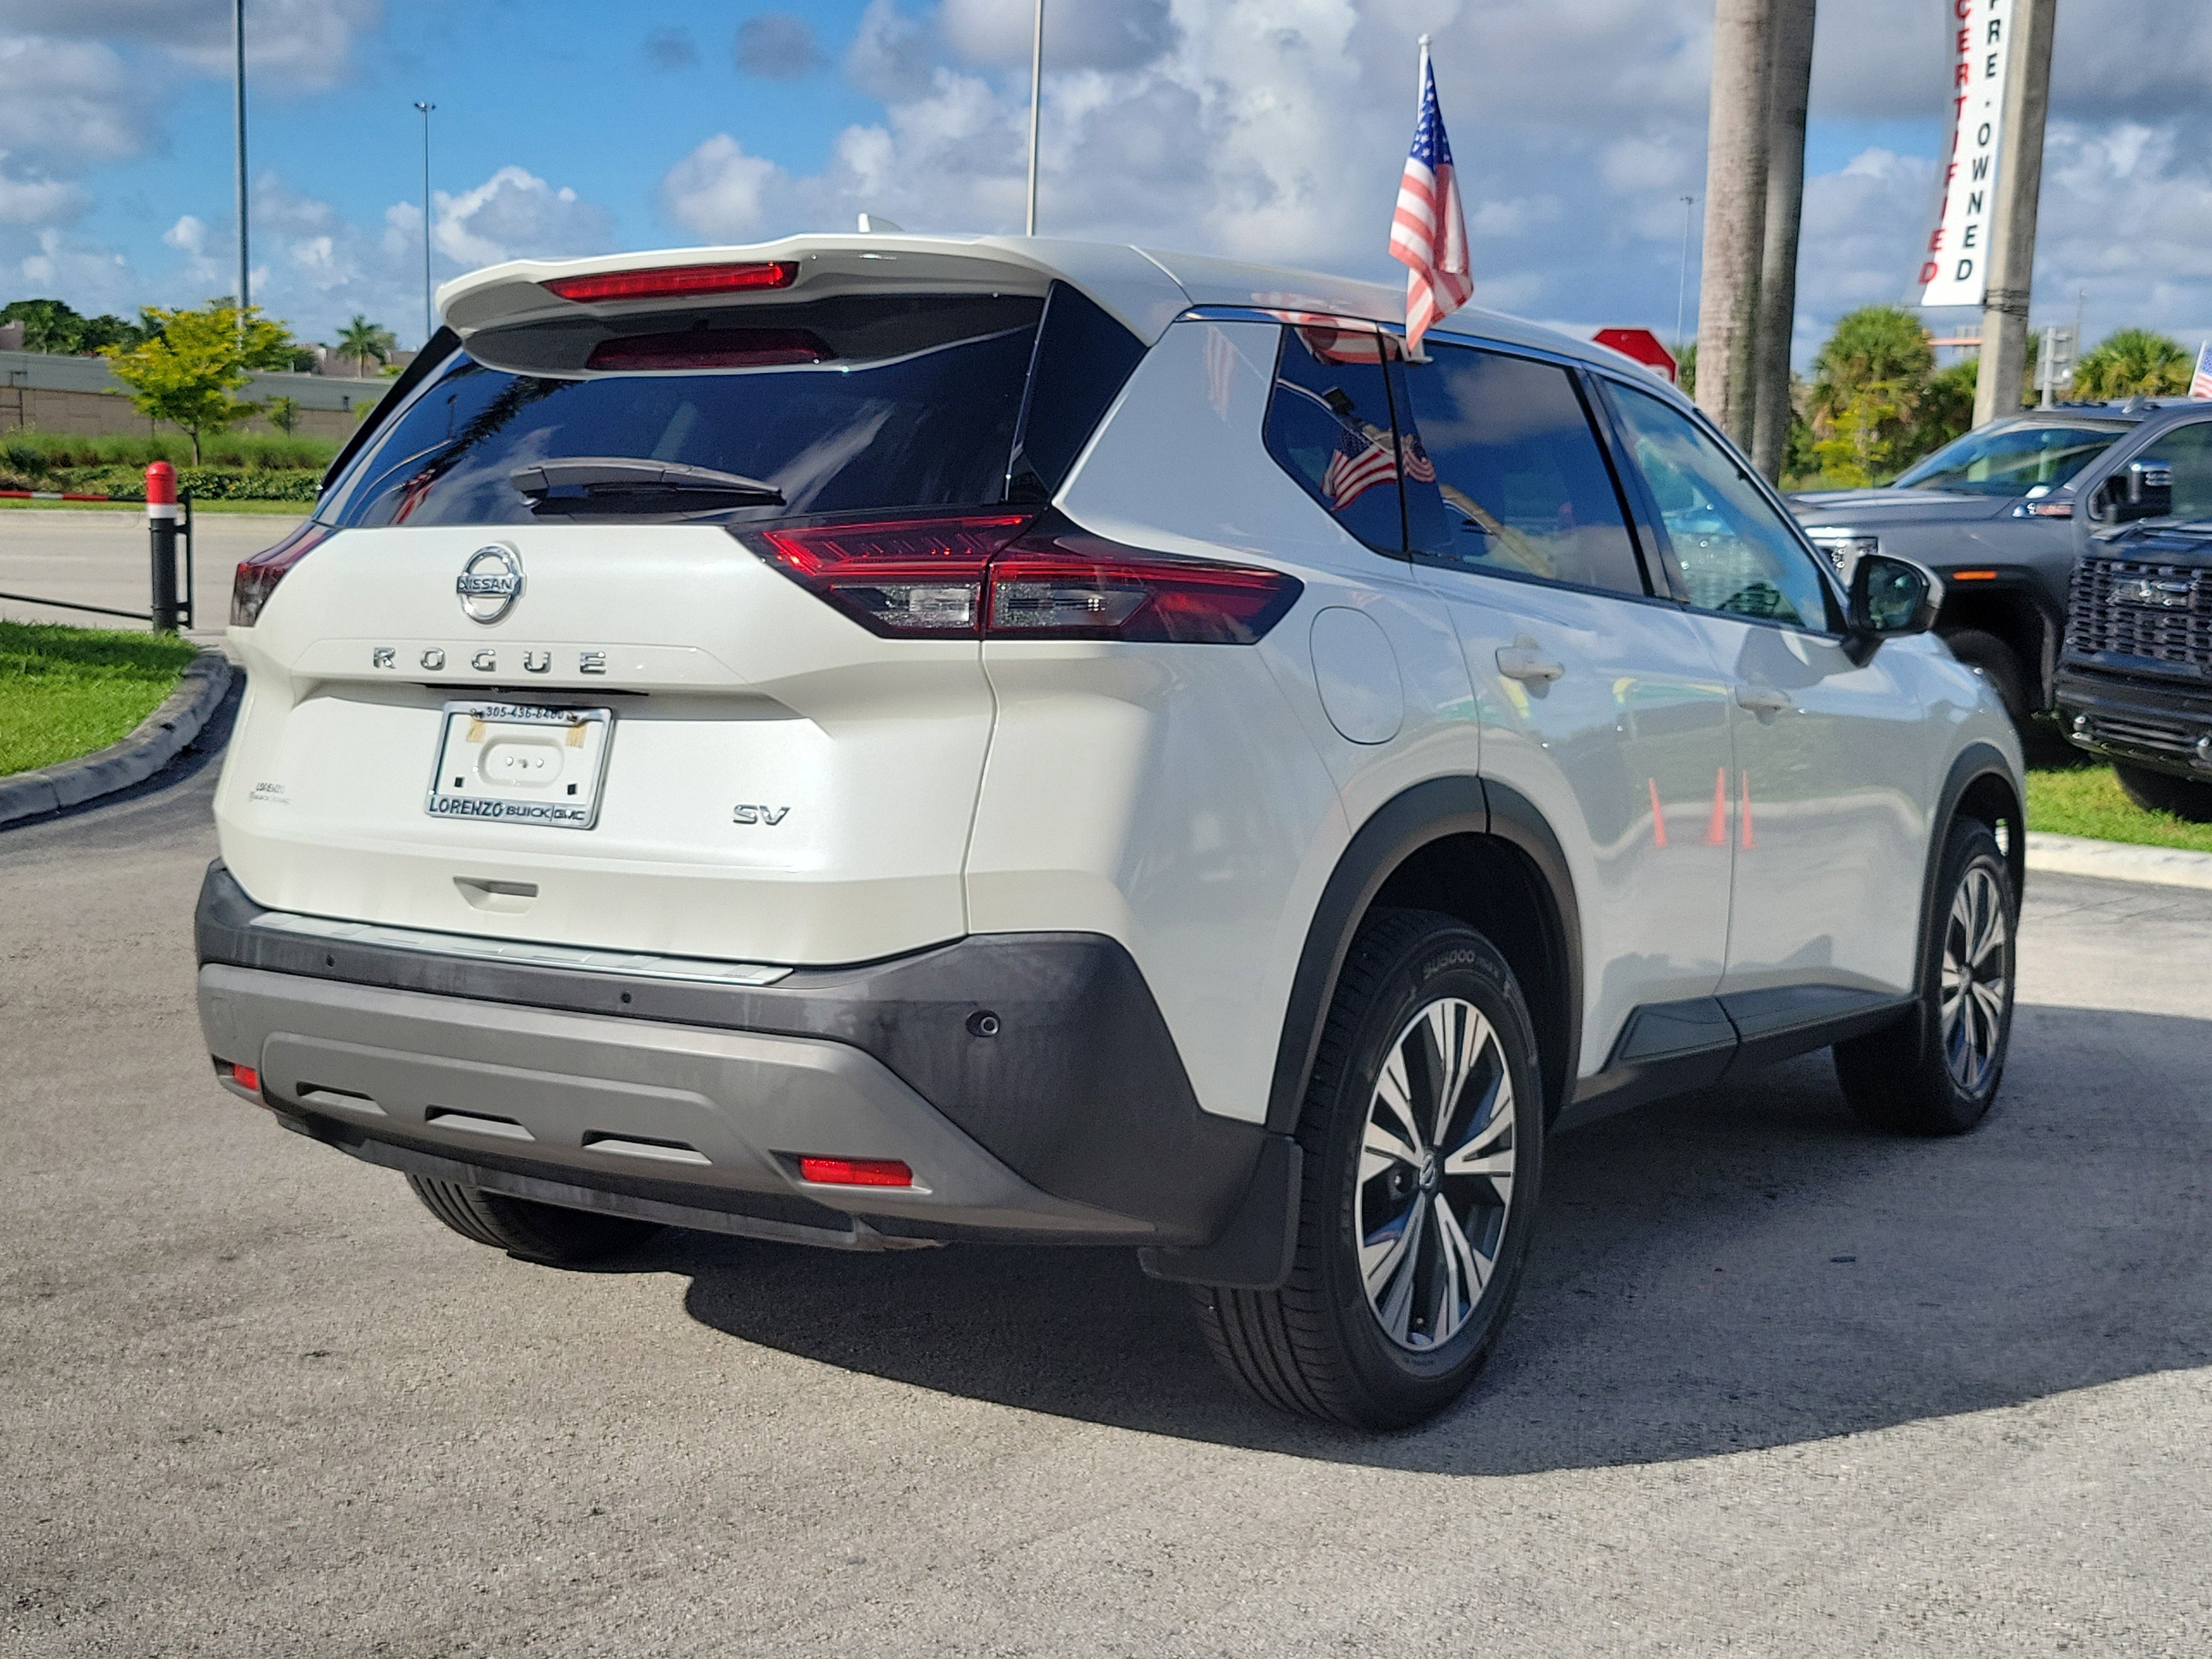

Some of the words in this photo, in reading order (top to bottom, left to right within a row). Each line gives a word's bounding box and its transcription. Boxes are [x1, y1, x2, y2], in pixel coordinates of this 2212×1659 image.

[1918, 0, 1972, 285] CERTIFIED
[459, 577, 513, 590] NISSAN
[374, 647, 607, 674] ROGUE
[429, 797, 505, 817] LORENZO
[732, 804, 791, 826] SV
